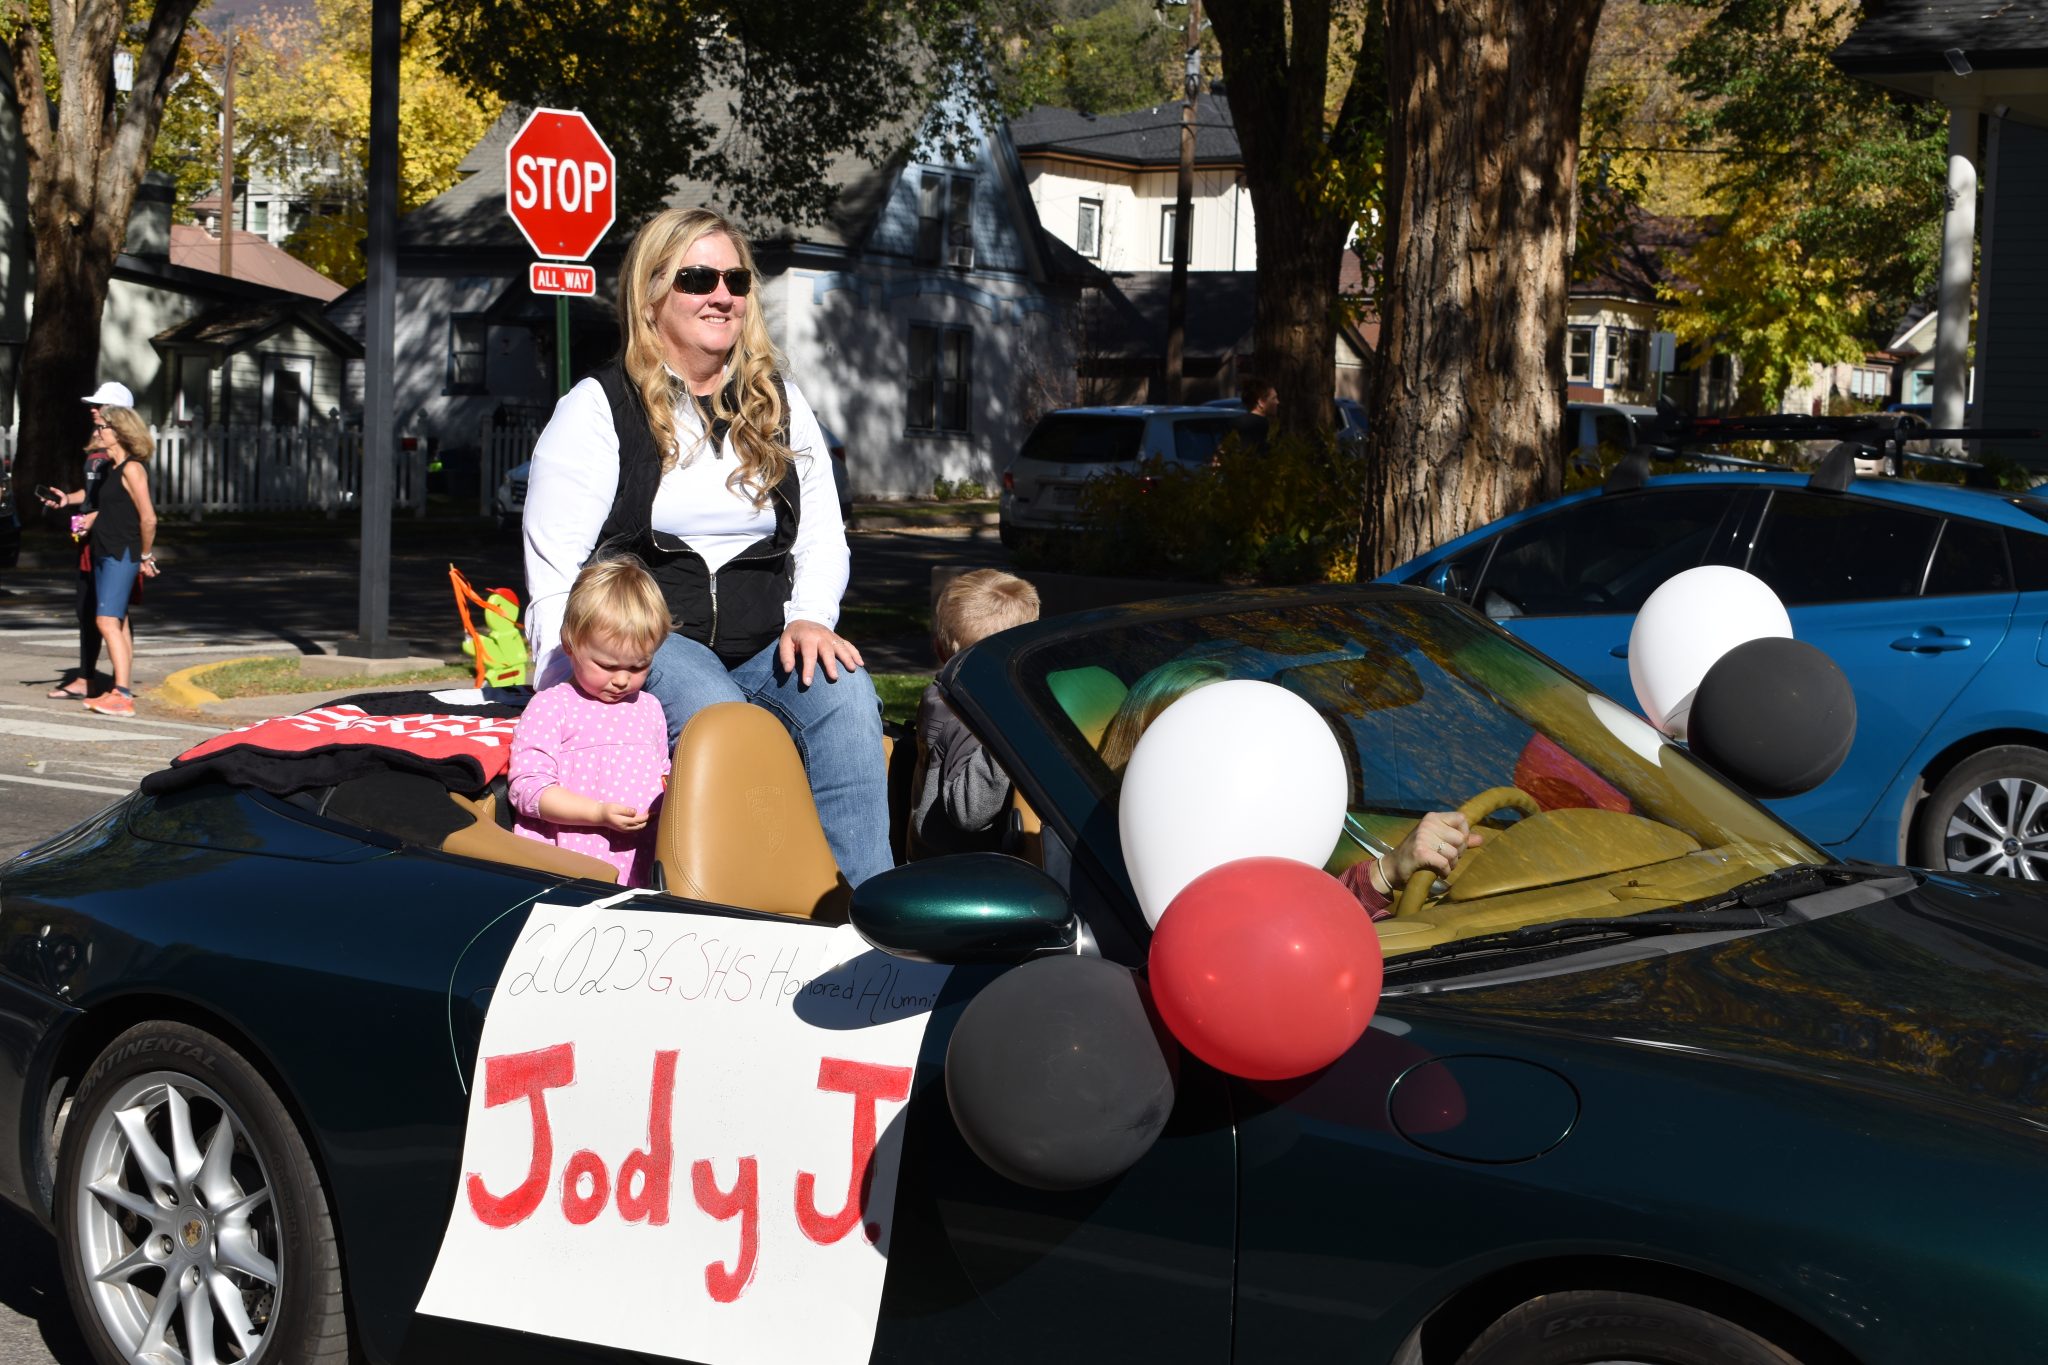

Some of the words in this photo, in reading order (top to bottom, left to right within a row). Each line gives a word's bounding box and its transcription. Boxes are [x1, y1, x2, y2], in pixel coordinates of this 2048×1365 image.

[515, 154, 607, 213] STOP
[537, 270, 559, 288] ALL
[564, 271, 589, 290] WAY
[508, 923, 654, 997] 2023
[759, 945, 859, 1007] Honored
[856, 963, 937, 1024] Alumni
[72, 1037, 218, 1121] CONTINENTAL
[465, 1041, 761, 1303] Jody
